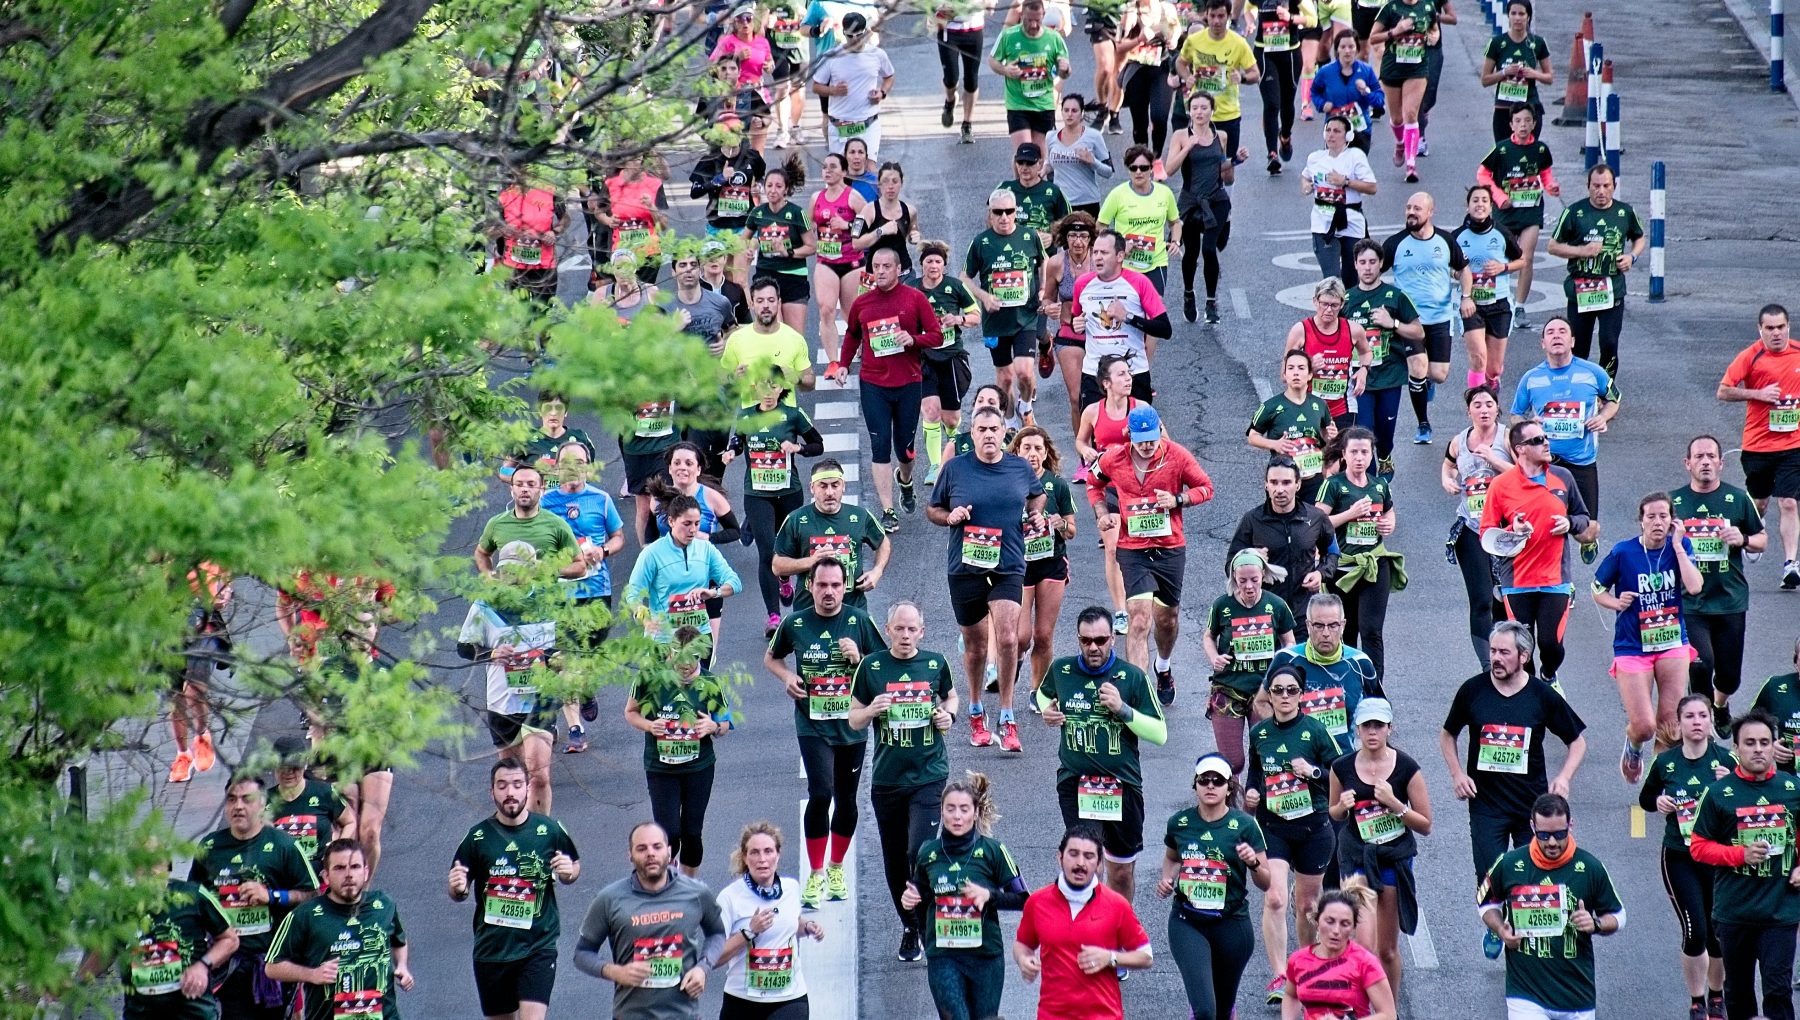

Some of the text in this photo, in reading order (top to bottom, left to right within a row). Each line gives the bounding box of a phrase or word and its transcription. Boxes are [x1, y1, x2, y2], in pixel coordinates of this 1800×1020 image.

[1322, 357, 1349, 365] NMARK
[1318, 382, 1341, 394] F40529
[1554, 421, 1572, 431] 26301
[758, 473, 781, 483] F41915
[1139, 519, 1159, 529] 43163
[1697, 542, 1718, 552] 42954
[973, 549, 993, 561] 42936
[1639, 589, 1676, 607] FOR THE
[1649, 632, 1674, 643] F41624
[810, 643, 821, 652] edp
[1241, 639, 1267, 652] F40676
[1073, 691, 1085, 701] edp
[823, 701, 844, 712] 42804
[1065, 701, 1092, 710] MADRID
[901, 708, 924, 719] 41756
[1492, 752, 1515, 764] 42572
[1092, 800, 1113, 810] 41644
[1276, 796, 1303, 814] F40694
[1368, 818, 1396, 837] F40897
[1181, 851, 1206, 860] MADRID
[488, 867, 517, 877] MADRID
[933, 885, 957, 895] MADRID
[1187, 885, 1217, 900] F40834
[500, 903, 524, 918] 42859
[236, 911, 260, 924] 42384
[1528, 913, 1553, 927] 42659
[943, 922, 973, 937] F41987
[330, 942, 360, 953] MADRID
[651, 963, 674, 976] 2630
[149, 970, 174, 983] 40821
[757, 975, 786, 989] F41439
